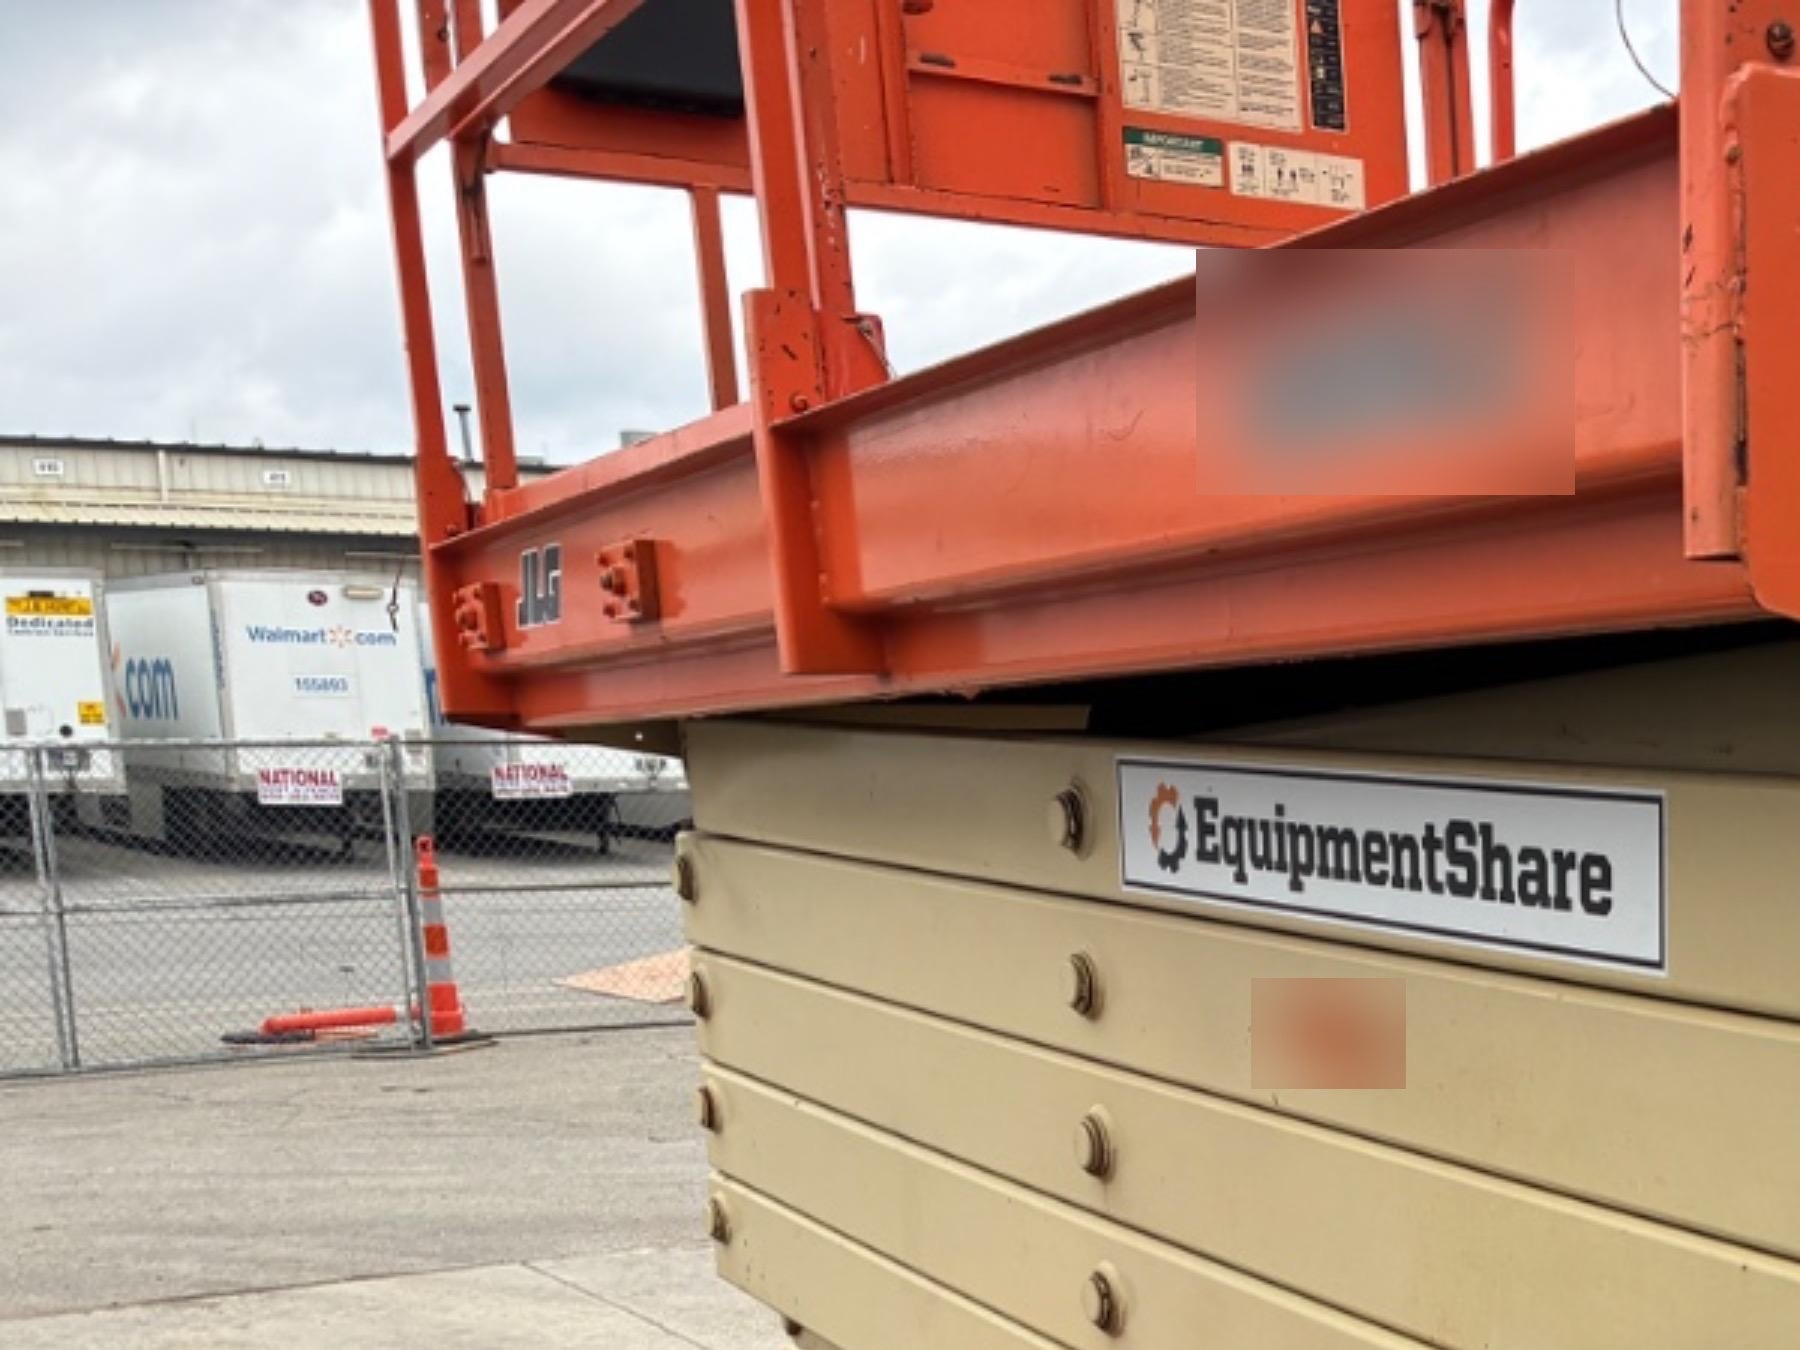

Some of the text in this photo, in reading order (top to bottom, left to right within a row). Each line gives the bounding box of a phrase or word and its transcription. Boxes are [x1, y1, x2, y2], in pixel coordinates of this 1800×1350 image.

[516, 543, 563, 630] JLG
[246, 626, 326, 644] Walmart
[259, 768, 339, 787] NATIONAL
[494, 764, 568, 783] NATIONAL
[1193, 795, 1613, 917] EquipmentShare
